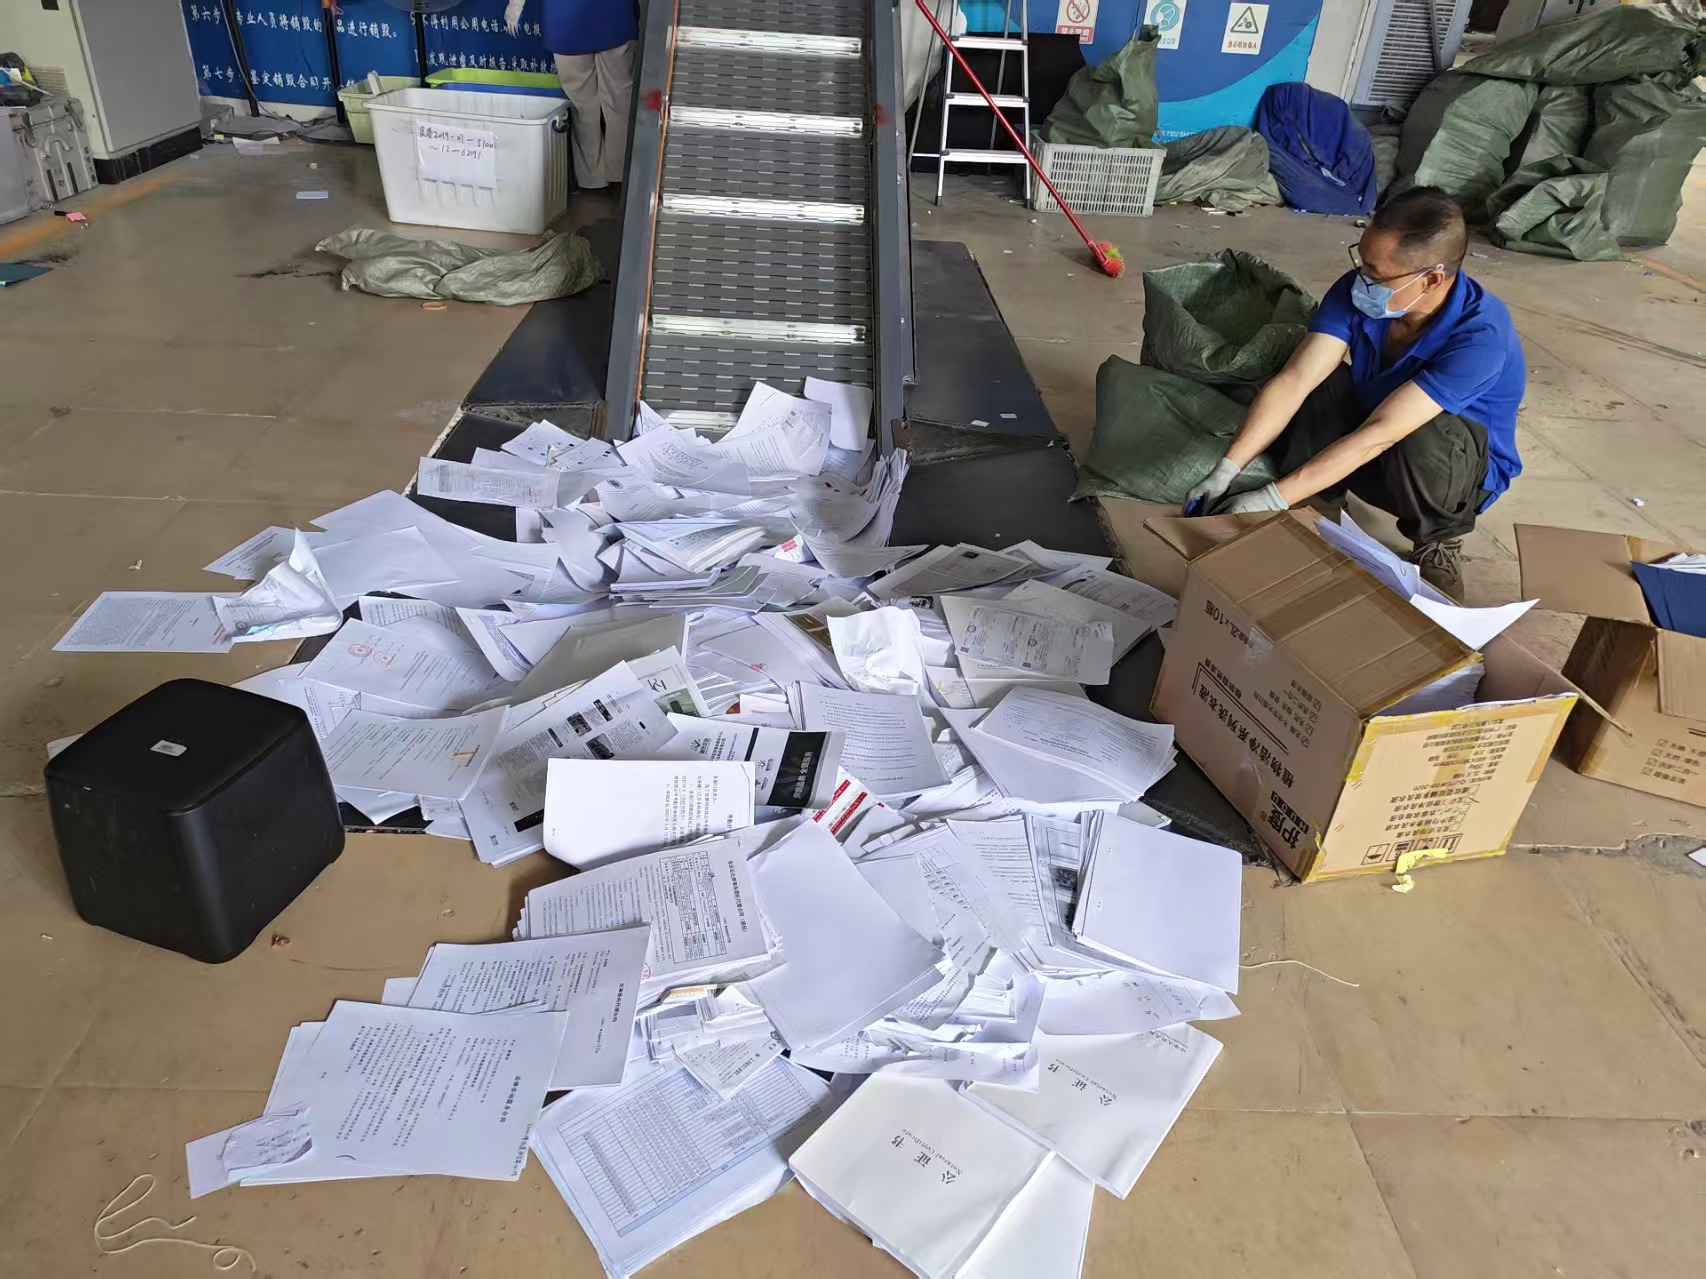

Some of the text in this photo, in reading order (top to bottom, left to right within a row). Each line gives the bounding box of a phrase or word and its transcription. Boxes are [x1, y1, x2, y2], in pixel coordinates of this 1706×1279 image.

[1199, 684, 1295, 789] 植物洁净系列洗衣液
[1267, 803, 1301, 850] 护度
[1048, 1062, 1113, 1107] 公证书
[891, 1135, 956, 1184] 公证书
